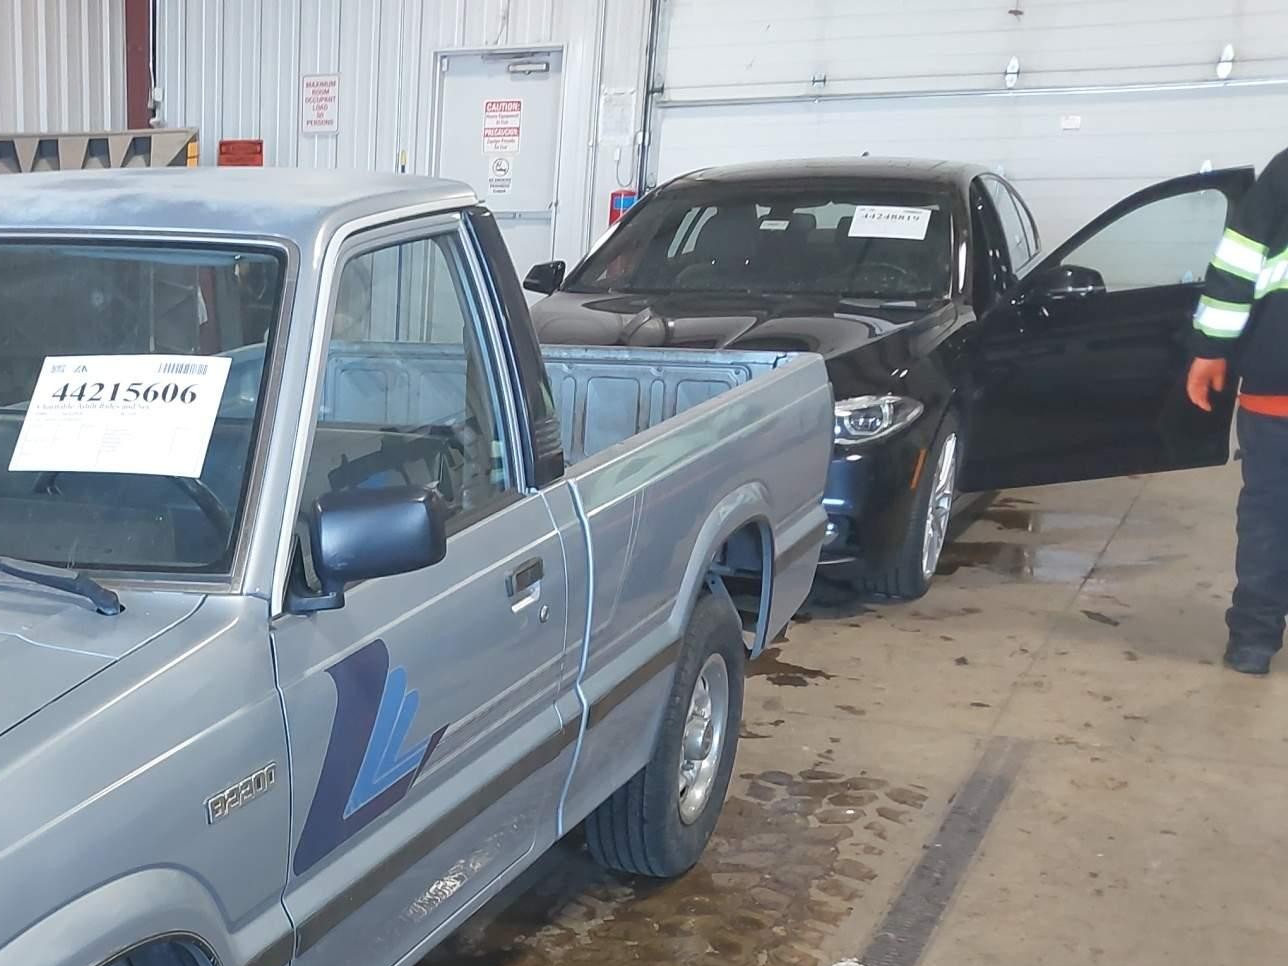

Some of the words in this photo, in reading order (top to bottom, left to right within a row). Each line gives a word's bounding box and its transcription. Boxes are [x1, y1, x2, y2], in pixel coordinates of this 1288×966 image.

[486, 102, 520, 111] CAUTION:
[52, 382, 200, 404] 44215606
[207, 761, 277, 824] B2200
